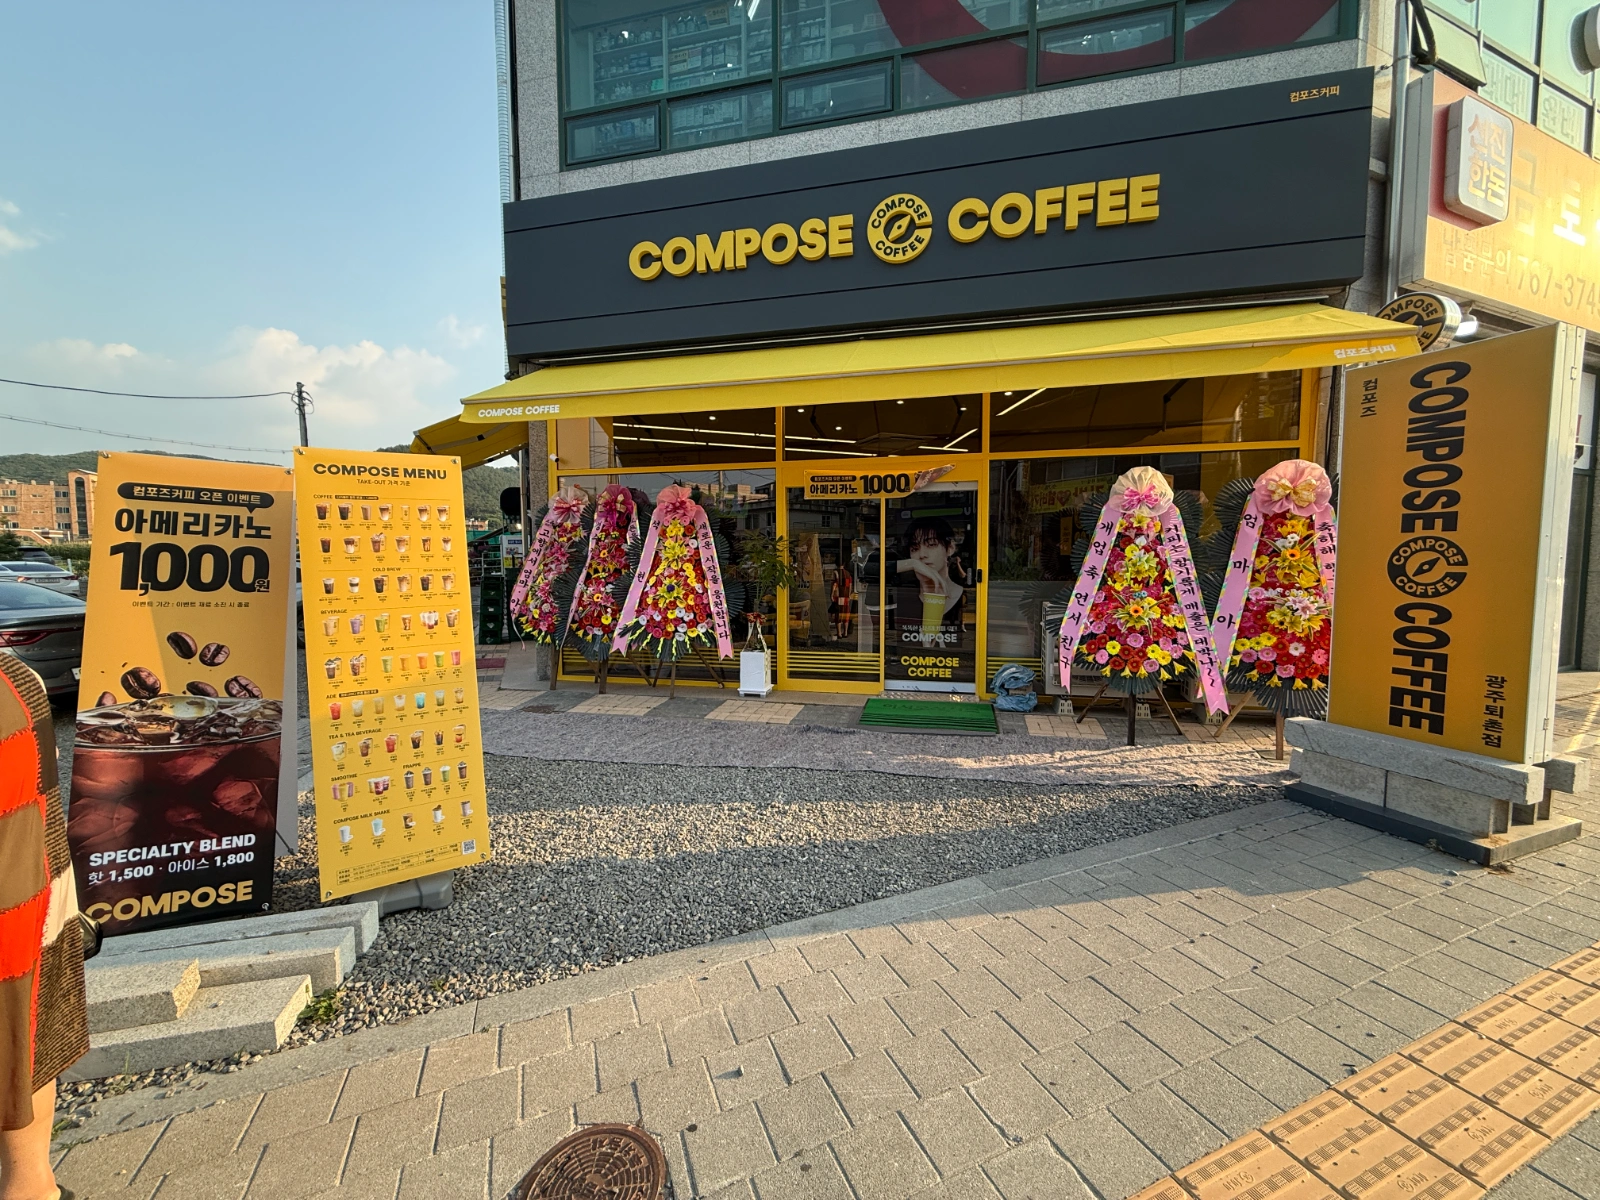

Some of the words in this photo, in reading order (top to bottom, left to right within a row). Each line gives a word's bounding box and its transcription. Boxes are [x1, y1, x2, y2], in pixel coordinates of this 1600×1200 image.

[1290, 85, 1340, 103] 컴포즈커피
[1467, 152, 1507, 208] 한돈
[871, 197, 928, 229] COMPOSE
[628, 213, 855, 281] COMPOSE
[947, 173, 1162, 244] COFFEE
[875, 234, 926, 258] COFFEE
[1334, 344, 1397, 359] 컴포즈커피
[1360, 377, 1378, 418] 컴포즈
[478, 407, 523, 417] COMPOSE
[525, 404, 560, 415] COFFEE
[1401, 360, 1472, 534] COMPOSE
[313, 463, 400, 478] COMPOSE
[402, 467, 447, 480] MENU
[357, 478, 386, 486] TAKE-OUT
[133, 485, 195, 500] 컴포즈커피
[199, 490, 223, 502] 오픈
[227, 492, 261, 505] 이벤트
[809, 484, 858, 495] 아메리카노
[114, 508, 272, 540] 아메리카노
[1392, 538, 1463, 564] COMPOSE
[705, 555, 720, 585] 시작을
[1395, 576, 1458, 596] COFFEE
[712, 589, 730, 640] 응원합니다
[901, 632, 958, 643] COMPOSE
[900, 655, 960, 667] COMPOSE
[907, 666, 953, 678] COFFEE
[1389, 602, 1453, 736] COFFEE
[1480, 675, 1508, 749] 광주퇴촌점
[355, 728, 382, 736] BEVERAGE
[333, 814, 359, 825] COMPOSE
[360, 812, 373, 820] MILK
[89, 841, 195, 867] SPECIALTY
[199, 833, 257, 852] BLEND
[88, 871, 104, 885] 핫
[109, 865, 154, 883] 1,500
[168, 857, 210, 873] 아이스
[214, 851, 255, 867] 1,800
[84, 879, 254, 925] COMPOSE
